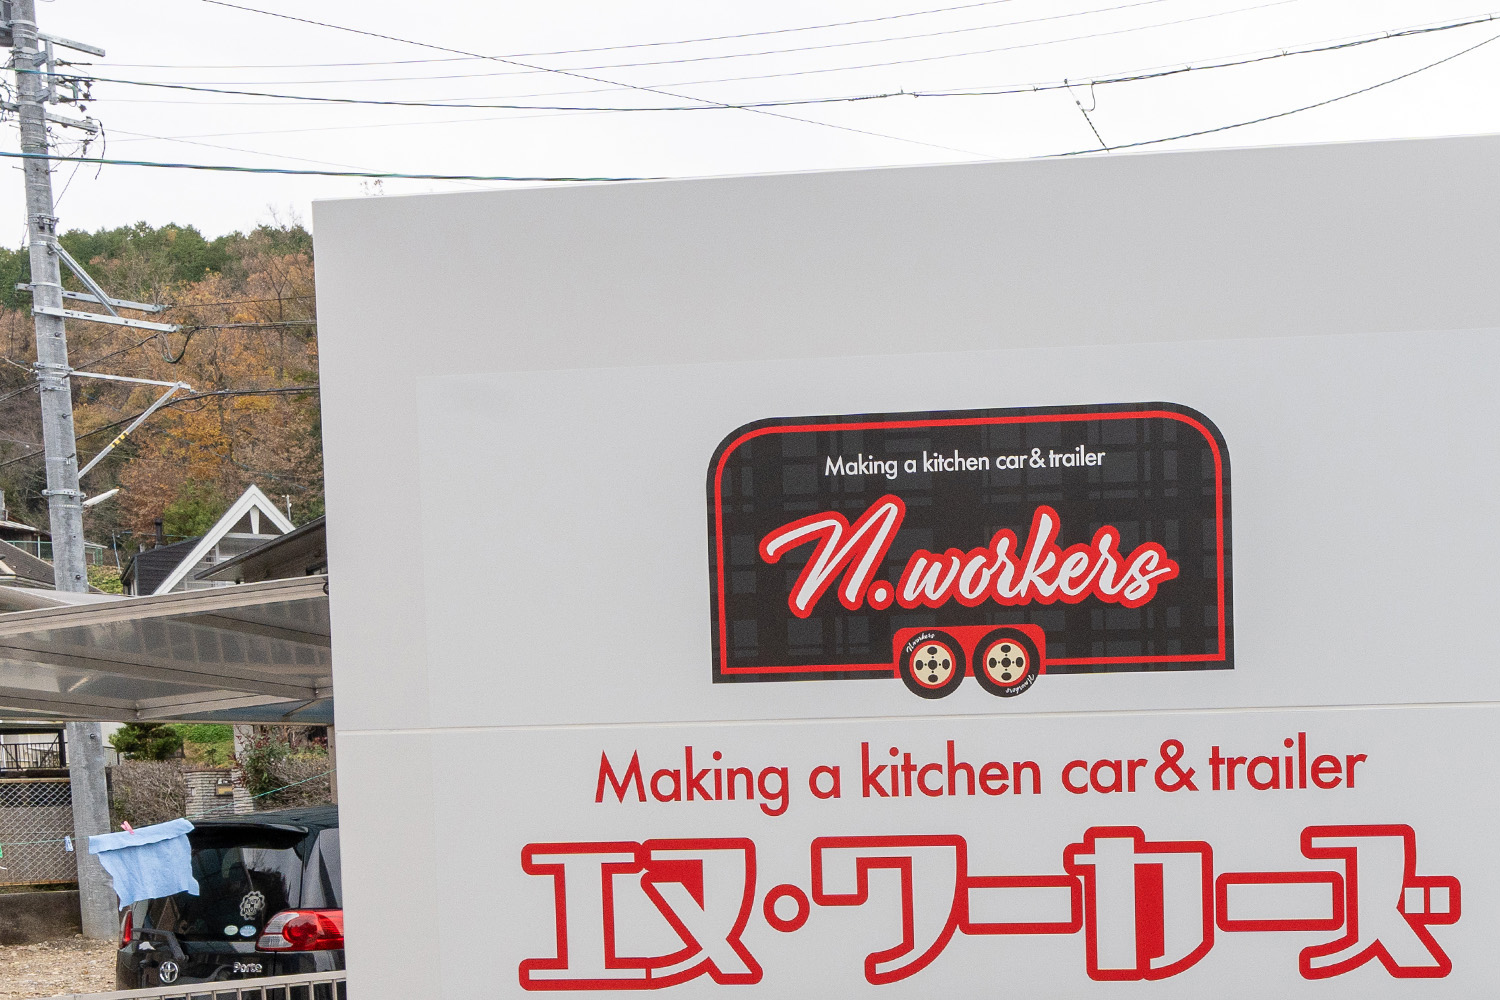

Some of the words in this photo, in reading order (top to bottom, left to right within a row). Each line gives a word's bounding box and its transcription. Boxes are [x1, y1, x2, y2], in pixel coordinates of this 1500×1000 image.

[825, 453, 898, 480] Making
[904, 459, 917, 474] a
[922, 450, 990, 472] kitchen
[594, 746, 790, 817] Making
[809, 765, 841, 799] a
[861, 740, 1042, 798] kitchen
